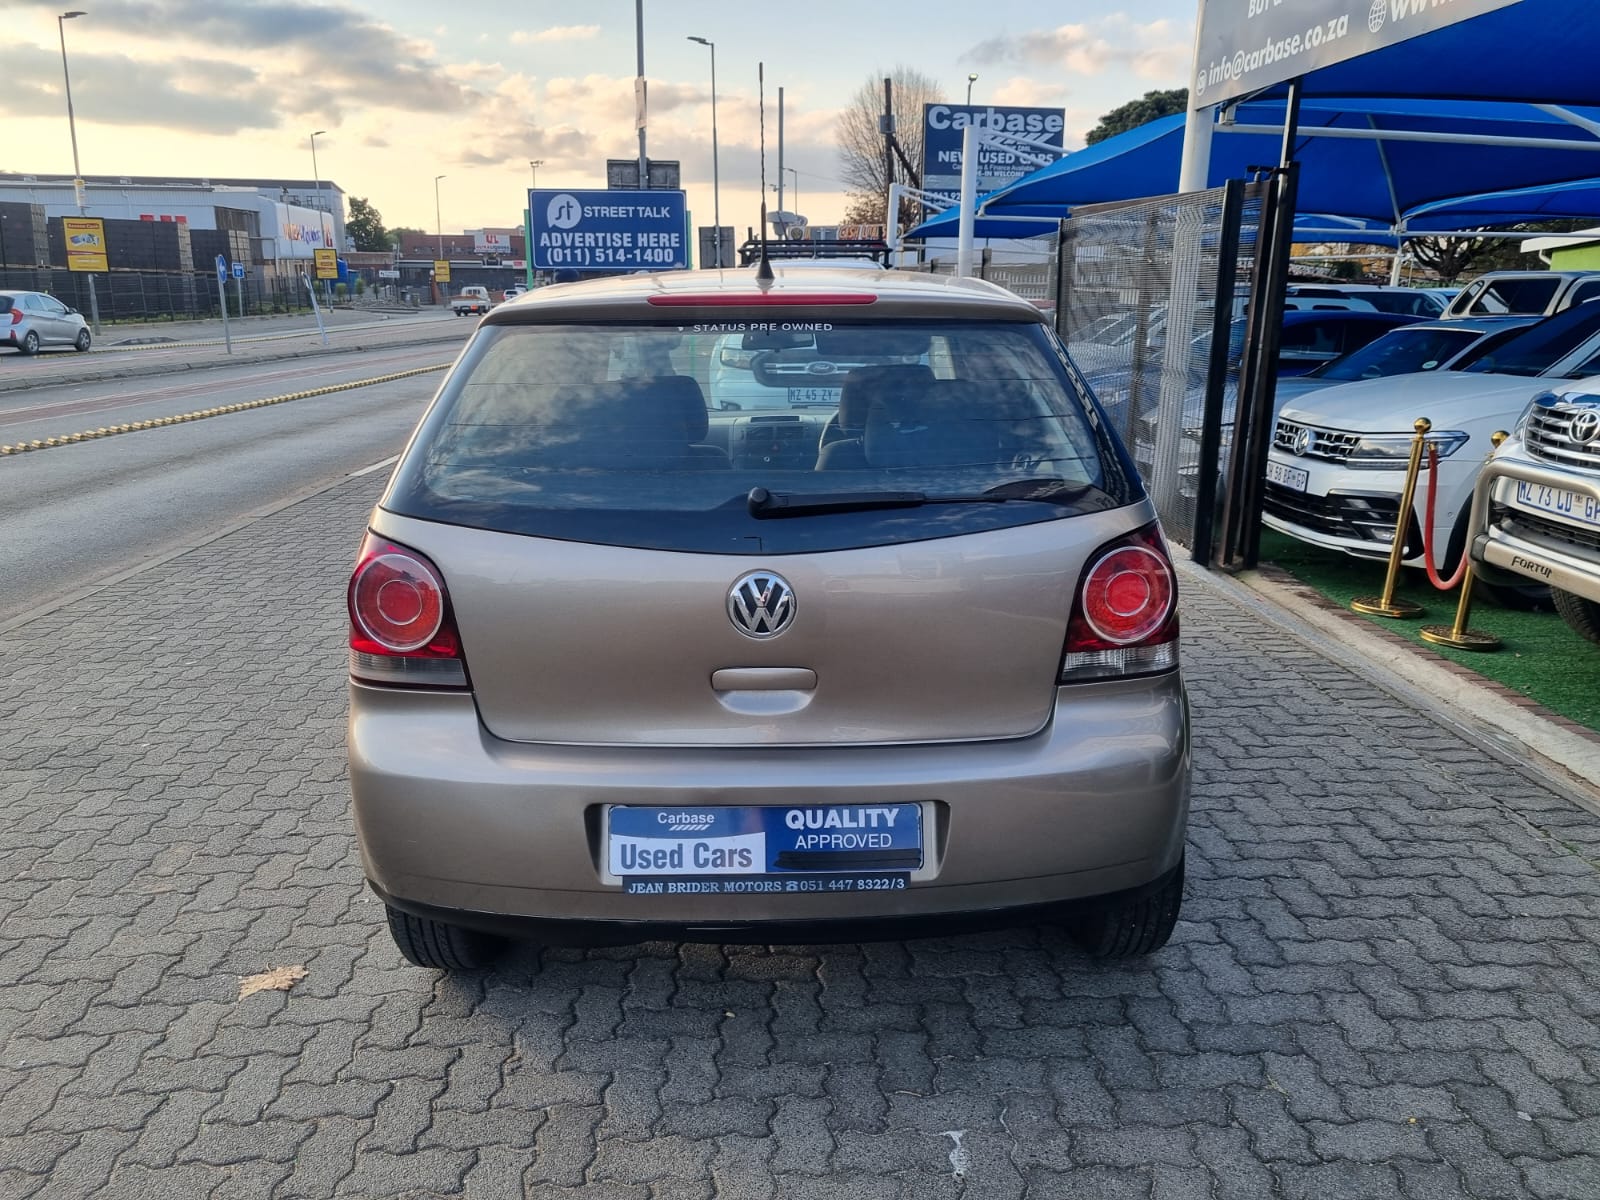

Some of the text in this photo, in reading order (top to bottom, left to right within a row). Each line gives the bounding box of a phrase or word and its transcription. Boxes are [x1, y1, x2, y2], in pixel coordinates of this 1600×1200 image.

[1208, 13, 1349, 86] info@carbase.co.za
[928, 106, 1063, 132] Carbase
[980, 152, 1015, 163] USED
[584, 206, 634, 218] STREET
[637, 206, 670, 218] TALK
[540, 232, 680, 247] ADVERTISE HERE
[547, 248, 674, 265] (011) 514-1400
[693, 323, 833, 332] STATUS PRE OWNED
[657, 812, 715, 824] Carbase
[785, 808, 899, 830] QUALITY
[795, 834, 892, 849] APPROVED
[621, 842, 752, 869] Used Cars
[628, 878, 905, 894] JEAN BRIDER MOTORS 051 447 8322/3
